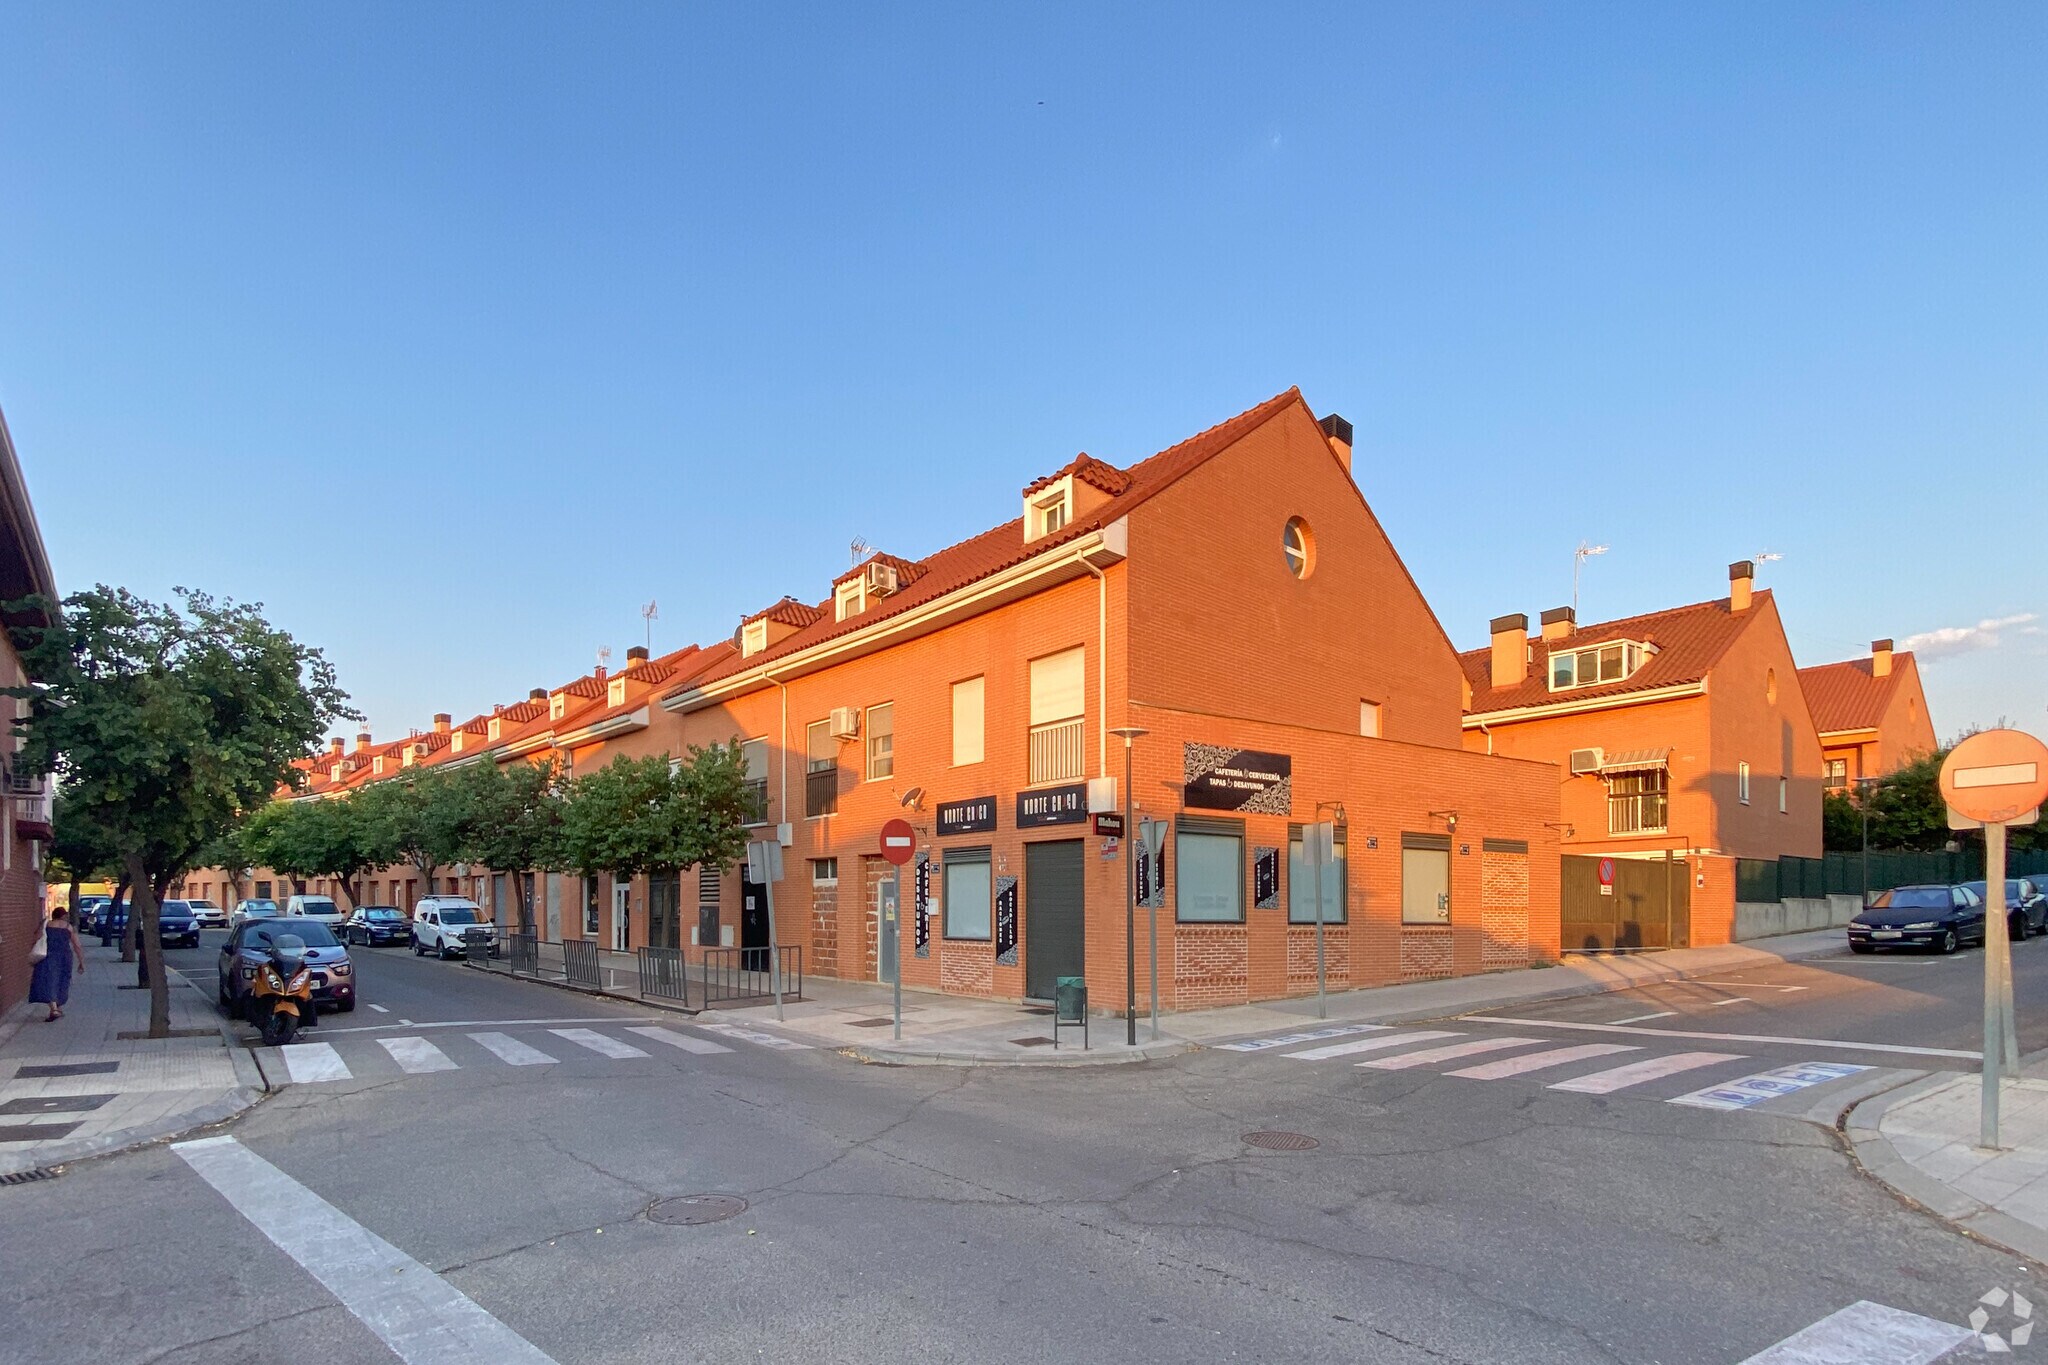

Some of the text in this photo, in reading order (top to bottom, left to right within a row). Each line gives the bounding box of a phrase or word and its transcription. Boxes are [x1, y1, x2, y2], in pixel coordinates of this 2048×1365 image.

[1214, 768, 1280, 781] CAFETERÍA CERVECERÍA
[1209, 778, 1264, 790] TAPAS DESAYUNOS
[1024, 797, 1047, 815] NORTE
